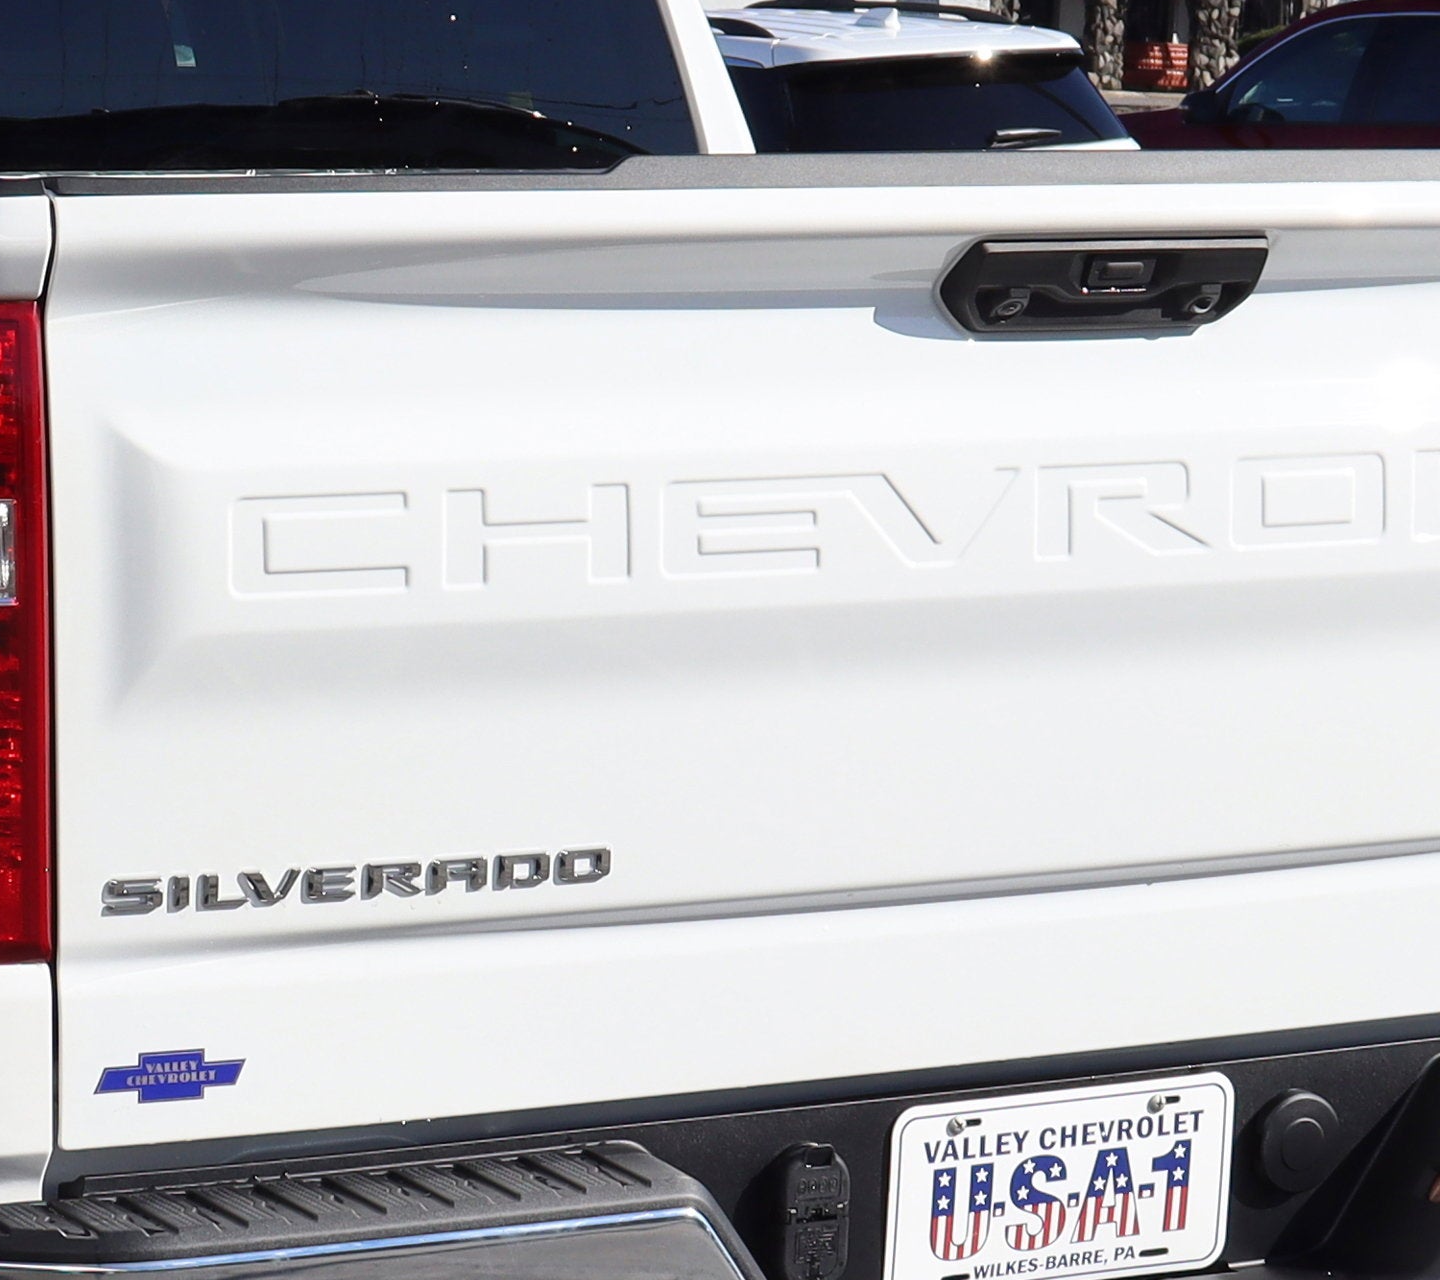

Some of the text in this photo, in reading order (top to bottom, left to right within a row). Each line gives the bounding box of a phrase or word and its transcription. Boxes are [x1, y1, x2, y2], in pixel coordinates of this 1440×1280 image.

[100, 846, 612, 917] SILVERADO
[126, 1070, 217, 1087] CHEVROLET
[145, 1060, 199, 1074] VALLEY
[924, 1109, 1205, 1164] VALLEY CHEVROLET
[973, 1246, 1136, 1280] WILKES-BARRE, PA
